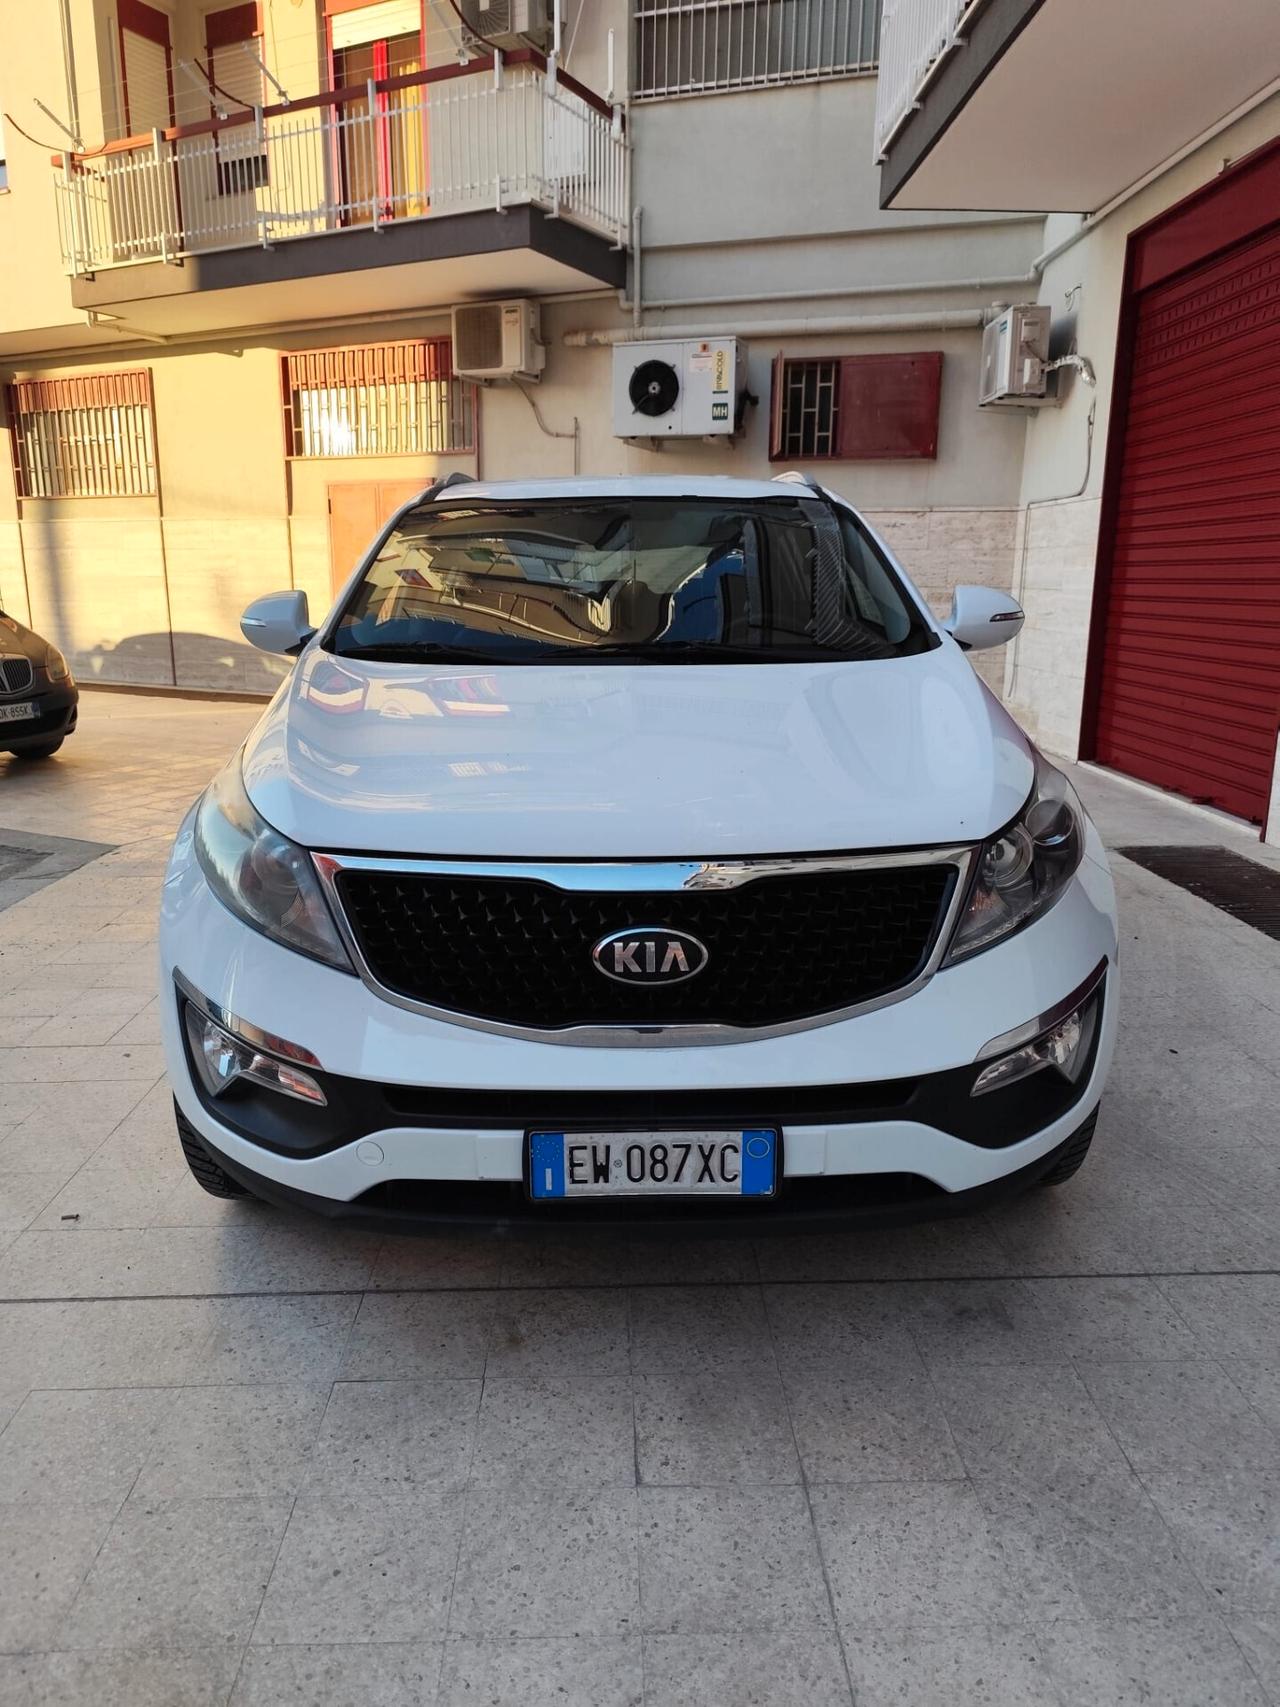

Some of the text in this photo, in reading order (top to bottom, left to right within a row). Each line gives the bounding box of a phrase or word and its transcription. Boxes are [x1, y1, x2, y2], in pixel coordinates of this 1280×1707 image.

[713, 407, 728, 417] MH
[613, 941, 690, 973] KIA
[569, 1143, 739, 1184] EW 087XC
